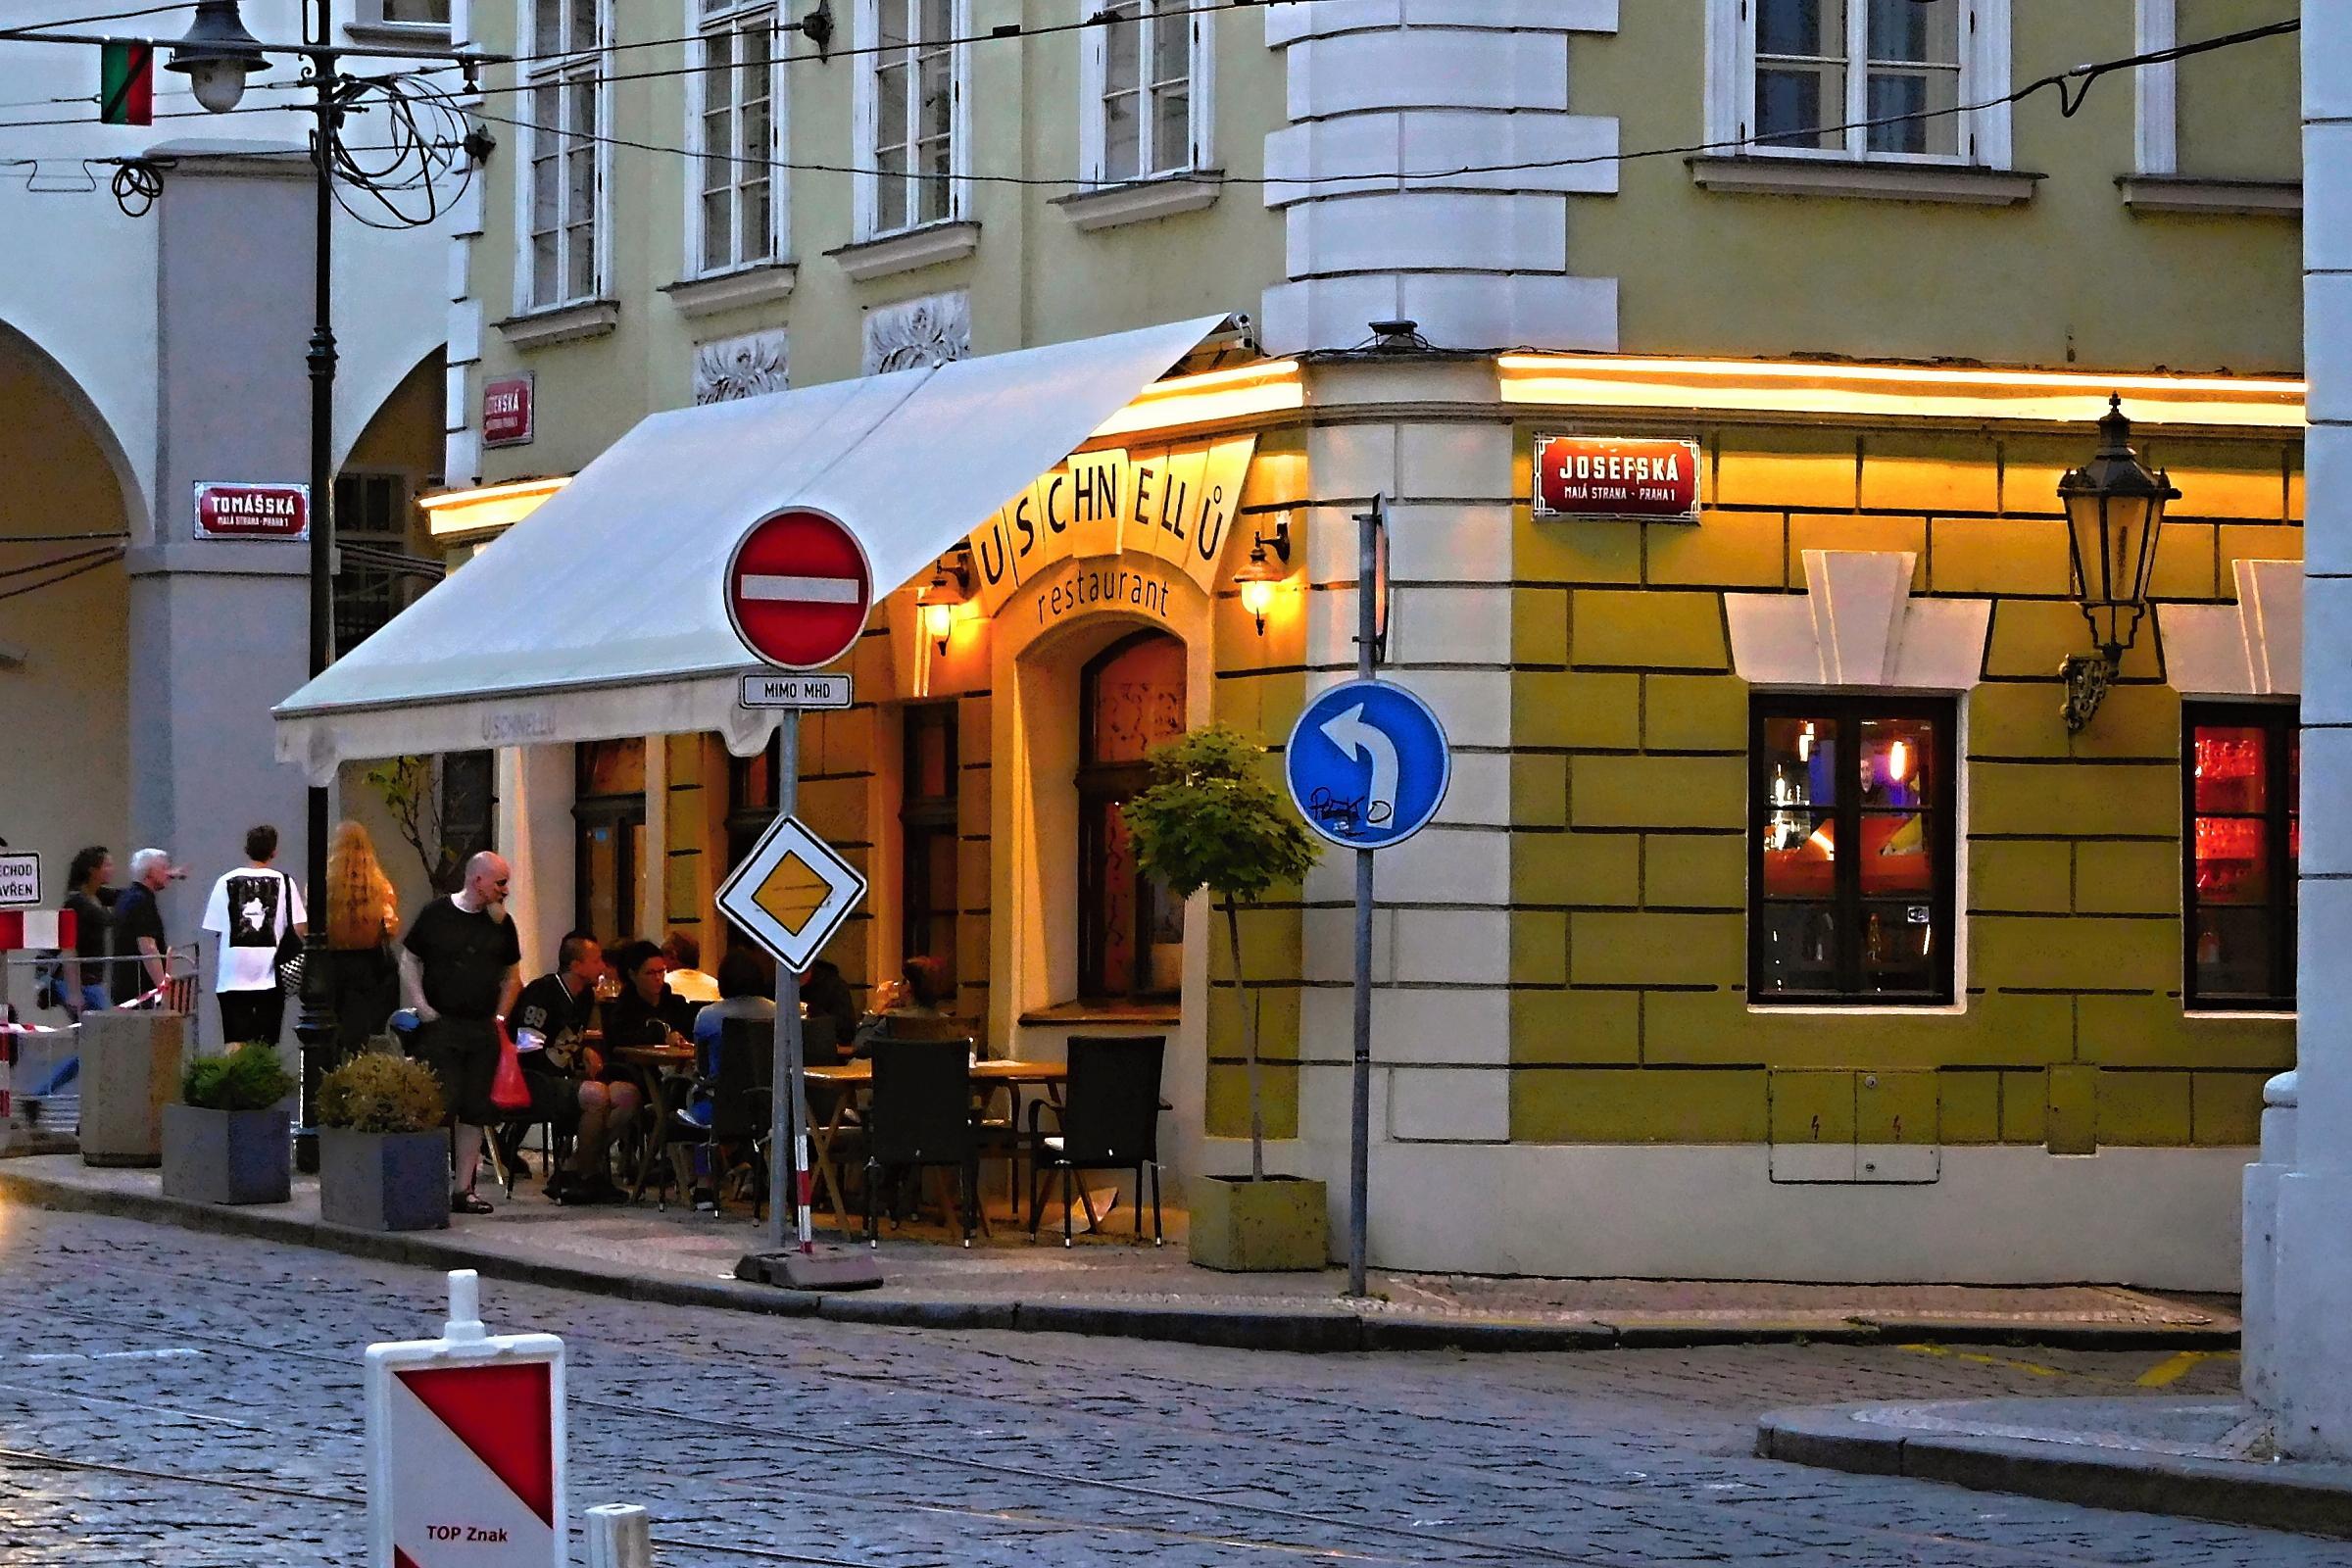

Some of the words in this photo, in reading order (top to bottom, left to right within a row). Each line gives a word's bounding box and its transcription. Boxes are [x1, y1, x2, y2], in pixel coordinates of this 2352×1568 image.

[1559, 454, 1679, 481] JOSEFSKÁ
[1564, 482, 1588, 499] MALÁ
[1592, 487, 1627, 500] STRANA
[1639, 488, 1669, 501] PRAHA
[1670, 489, 1675, 502] 1
[211, 494, 295, 514] TOMÁŠSKÁ
[1038, 569, 1169, 624] restaurant
[764, 683, 798, 699] MIMO
[804, 683, 831, 699] MHD
[426, 1525, 462, 1541] TOP
[466, 1527, 508, 1542] Znak
